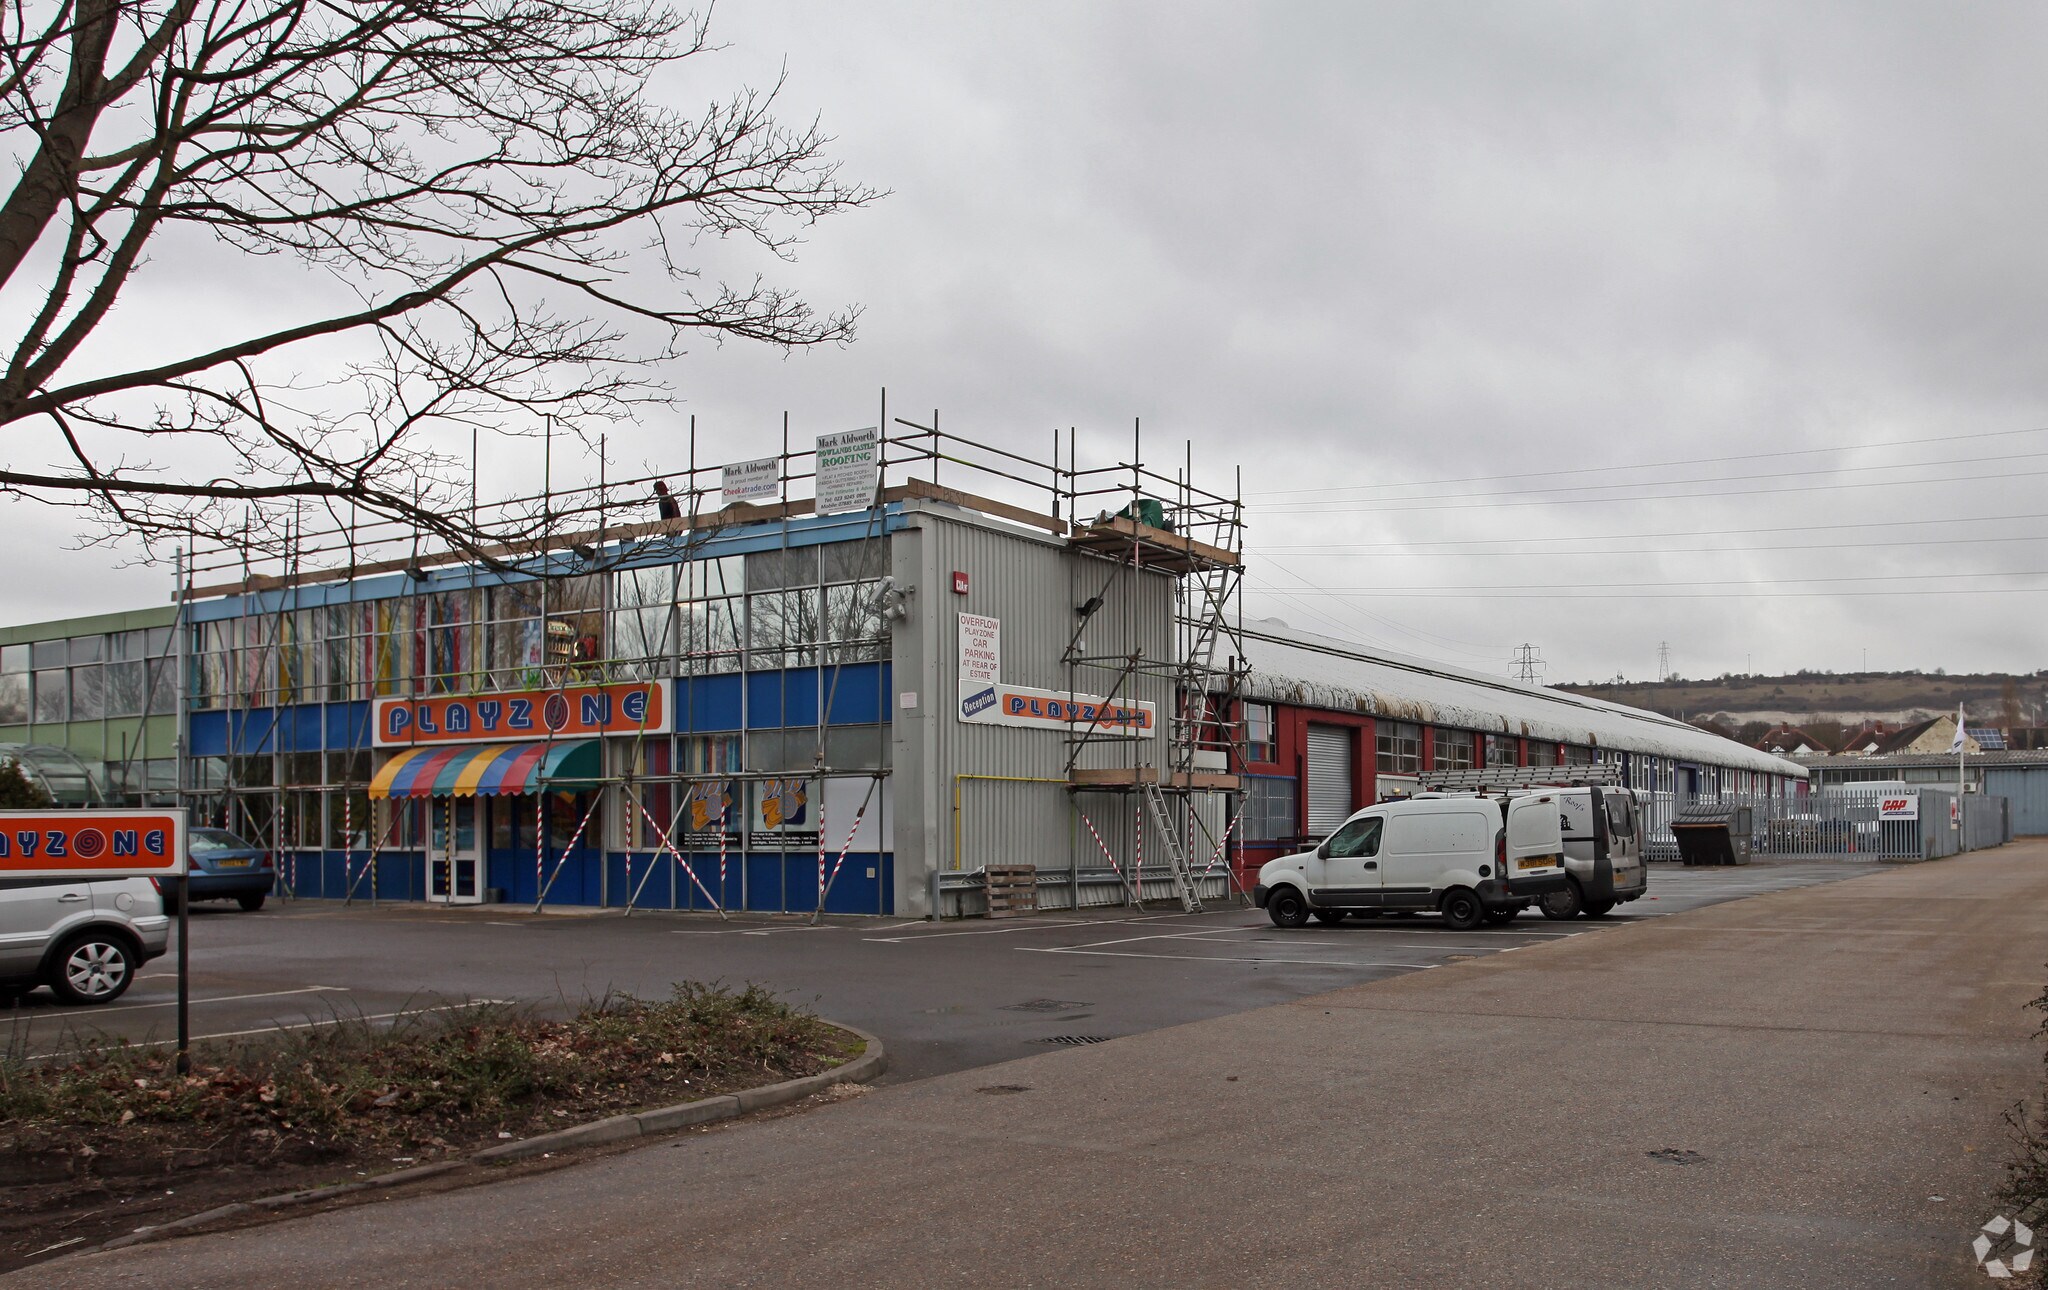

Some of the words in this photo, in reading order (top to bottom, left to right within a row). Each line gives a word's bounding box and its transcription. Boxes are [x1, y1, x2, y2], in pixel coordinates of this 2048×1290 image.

[818, 436, 838, 449] Mark
[840, 430, 875, 445] Aldworth
[818, 446, 852, 458] ROWLANDS
[852, 442, 876, 452] CASTLE
[821, 451, 872, 468] ROOFING
[724, 466, 742, 477] Mark
[745, 460, 776, 474] Aldworth
[960, 615, 999, 630] OVERFLOW
[964, 627, 994, 639] PLAYZONE
[972, 637, 988, 649] CAR
[964, 648, 995, 661] PARKING
[962, 659, 970, 667] AT
[972, 660, 988, 669] REAR
[970, 669, 991, 680] ESTATE
[963, 691, 995, 714] Reception
[388, 691, 649, 735] PLAYZONE
